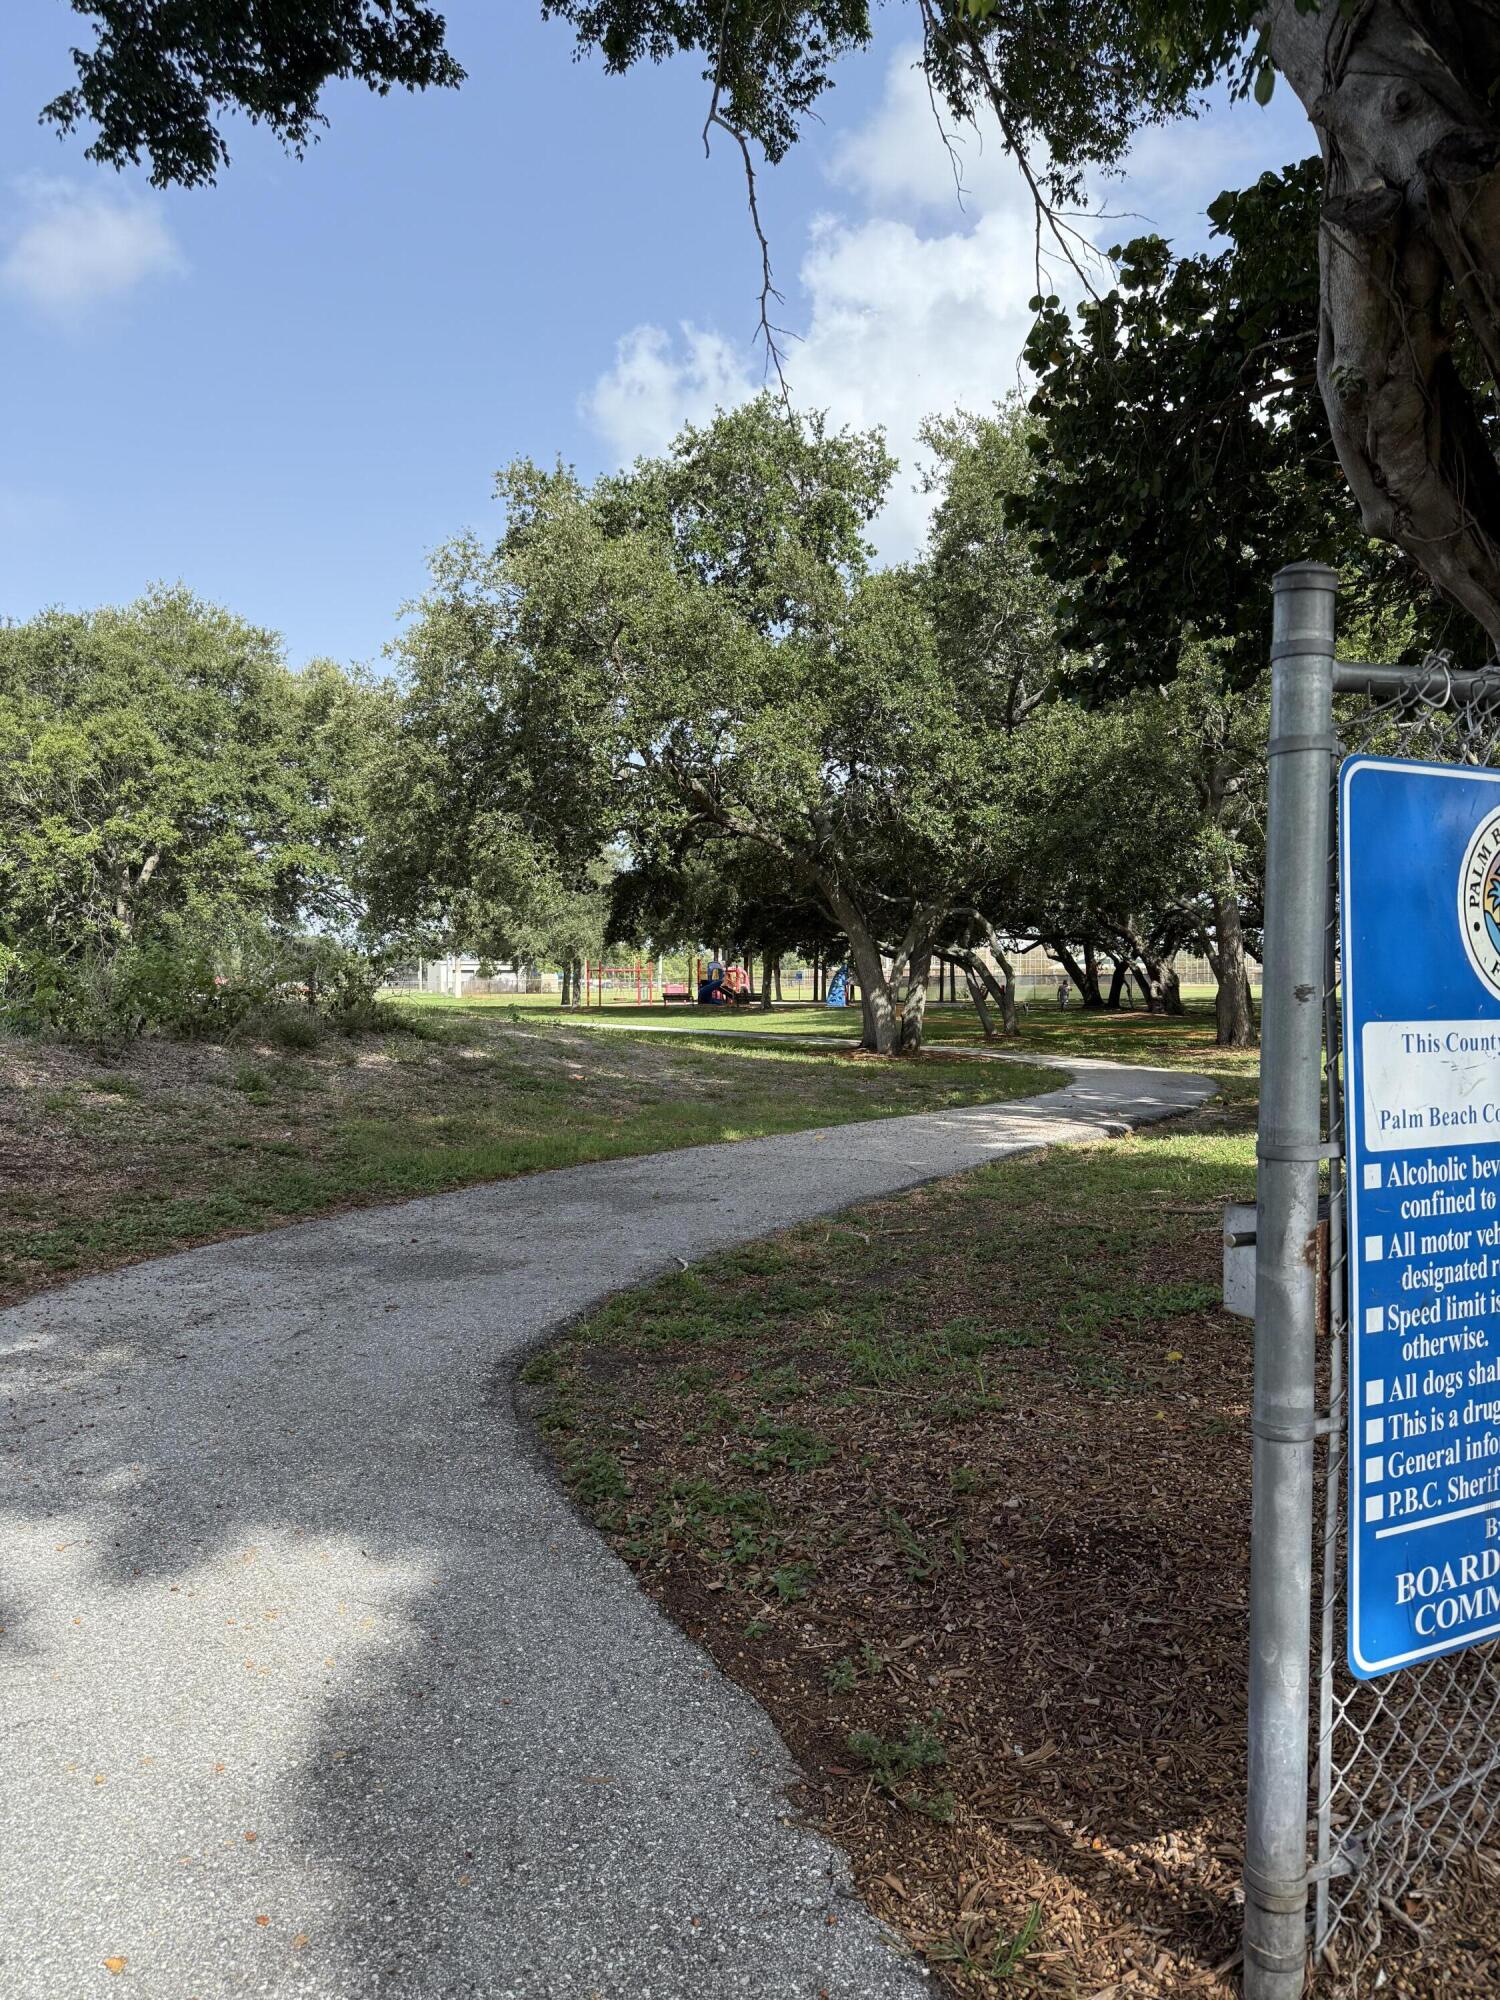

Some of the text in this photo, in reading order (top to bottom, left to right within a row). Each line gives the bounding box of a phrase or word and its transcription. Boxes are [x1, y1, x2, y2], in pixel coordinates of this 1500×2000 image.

[1469, 845, 1492, 908] PALM
[1402, 1032, 1500, 1056] This Count
[1380, 1109, 1423, 1130] Palm
[1429, 1105, 1477, 1127] Beach
[1387, 1154, 1500, 1188] Alcoholic bev
[1401, 1187, 1497, 1219] confined to
[1388, 1231, 1416, 1259] All
[1421, 1228, 1472, 1255] motor
[1402, 1253, 1500, 1293] designated r
[1388, 1297, 1441, 1337] Speed
[1446, 1291, 1487, 1321] limit
[1402, 1325, 1489, 1361] otherwise.
[1388, 1372, 1418, 1402] All
[1423, 1369, 1463, 1398] dogs
[1389, 1399, 1500, 1441] This is a drug
[1388, 1438, 1460, 1479] General
[1388, 1481, 1442, 1518] P.B.C.
[1395, 1549, 1500, 1605] BOARD
